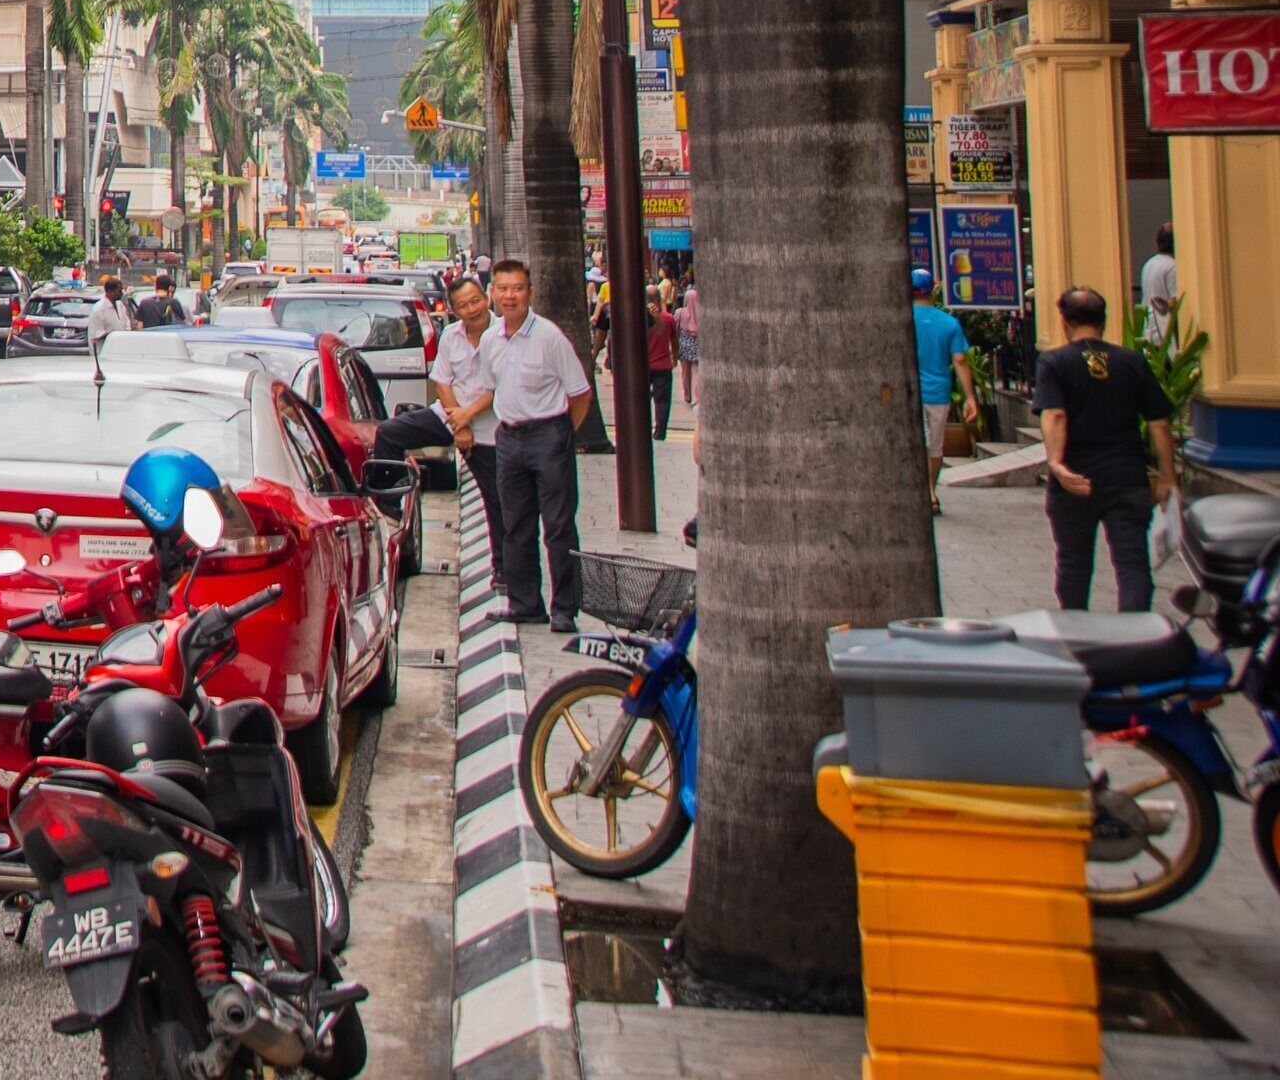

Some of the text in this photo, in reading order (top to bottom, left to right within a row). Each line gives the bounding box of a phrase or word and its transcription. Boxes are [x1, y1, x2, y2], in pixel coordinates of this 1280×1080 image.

[955, 131, 988, 141] 17.80
[957, 141, 989, 150] 70.00
[905, 147, 926, 157] ARK
[957, 162, 995, 172] 19.60
[578, 637, 608, 658] WTP
[73, 906, 110, 934] WB
[47, 919, 135, 960] 4447E
